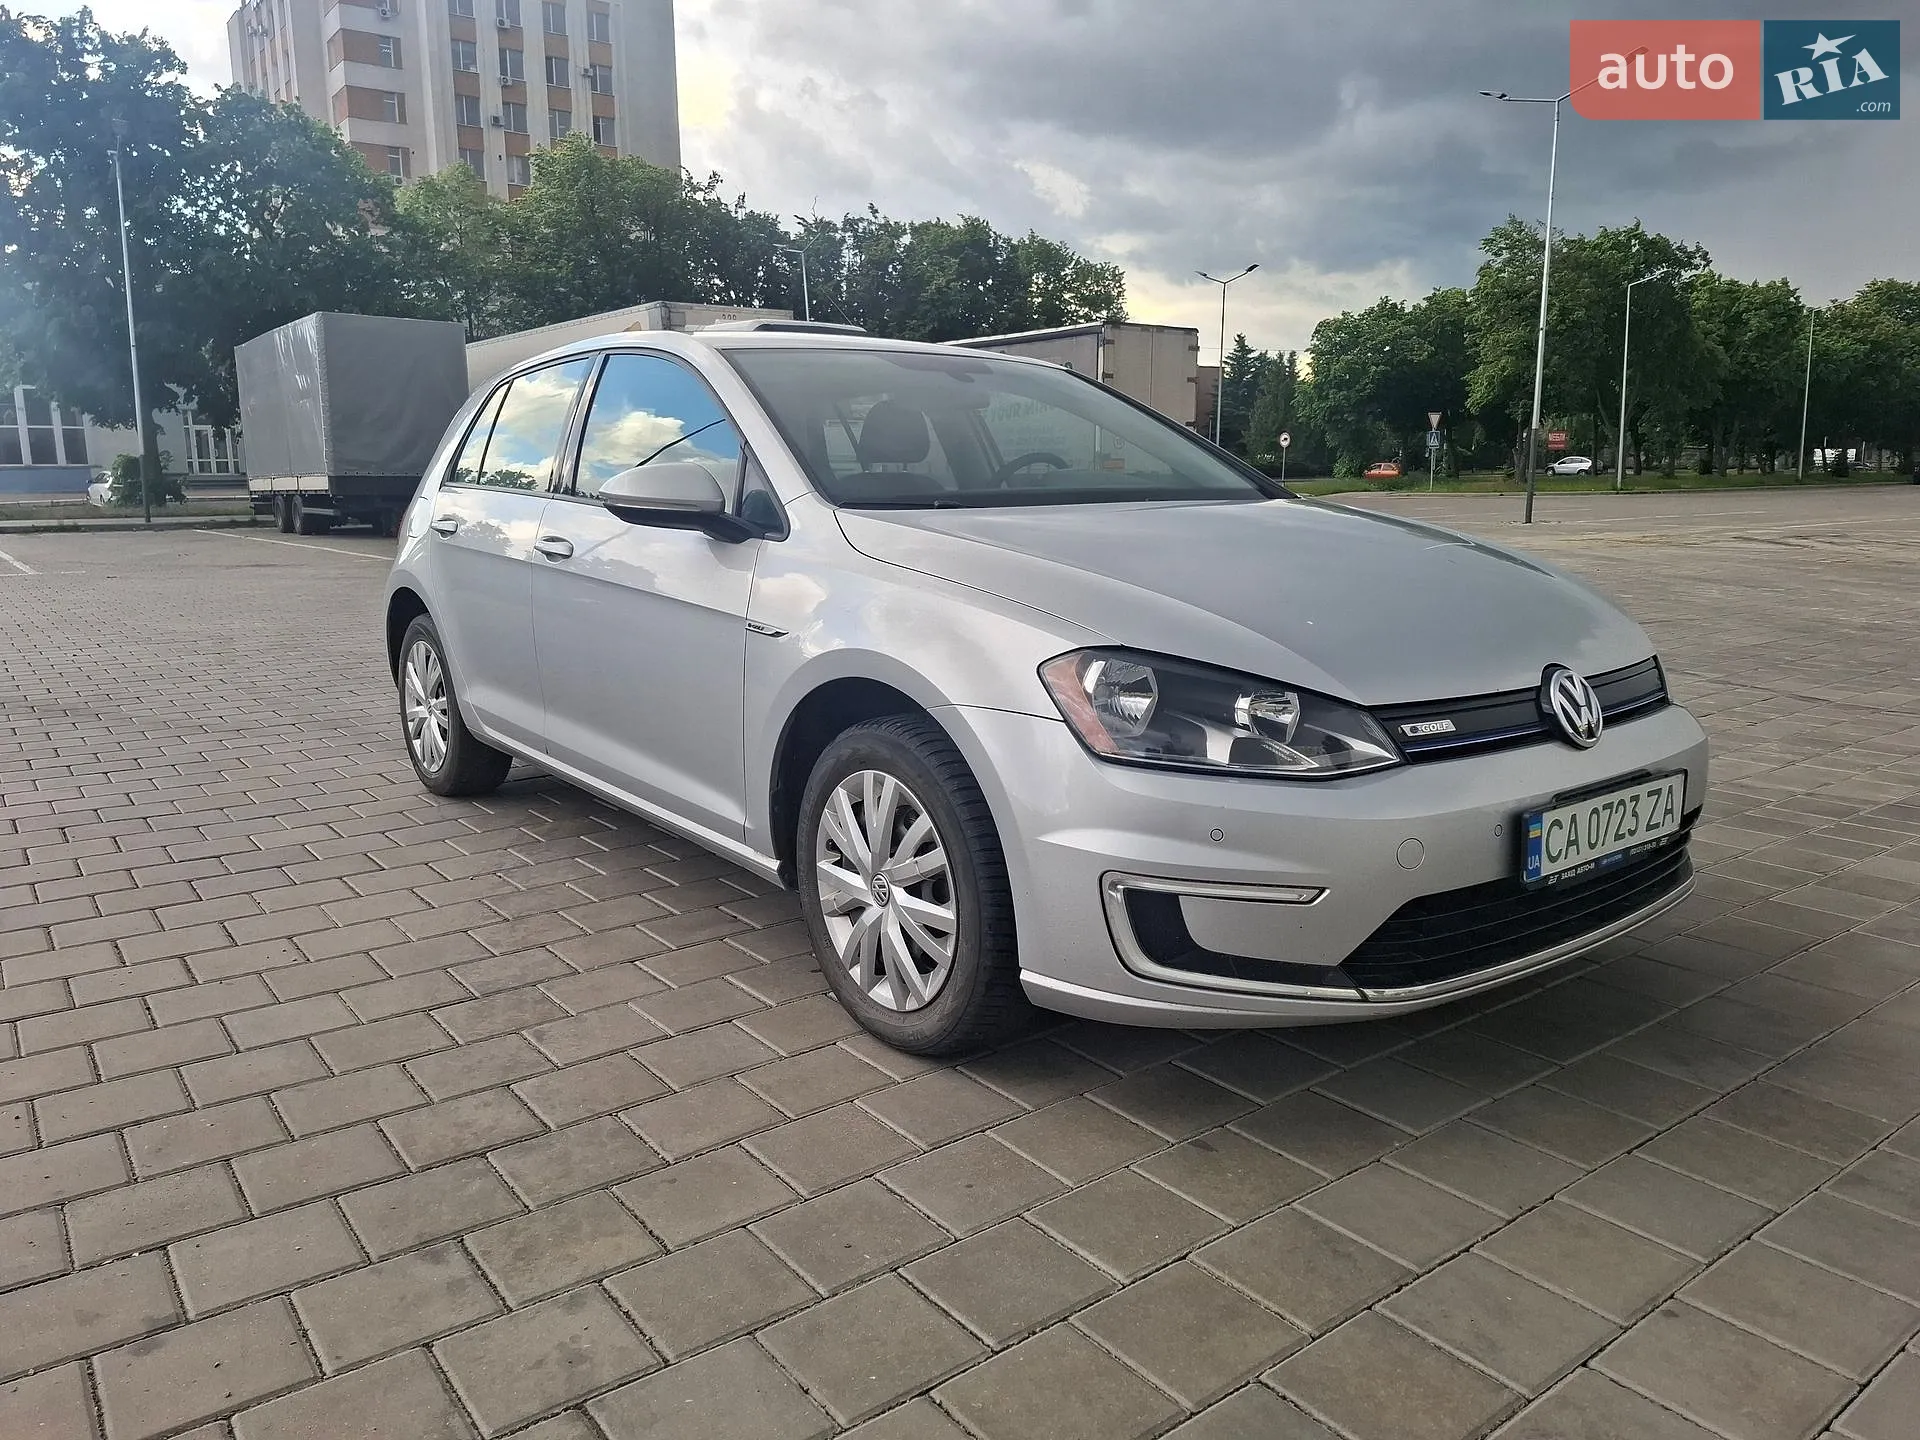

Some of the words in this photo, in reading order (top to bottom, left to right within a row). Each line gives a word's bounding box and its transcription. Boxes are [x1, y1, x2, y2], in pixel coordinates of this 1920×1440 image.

[1545, 813, 1581, 864] CA
[1587, 794, 1640, 850] 0723
[1645, 784, 1675, 832] ZA
[1528, 854, 1541, 871] UA
